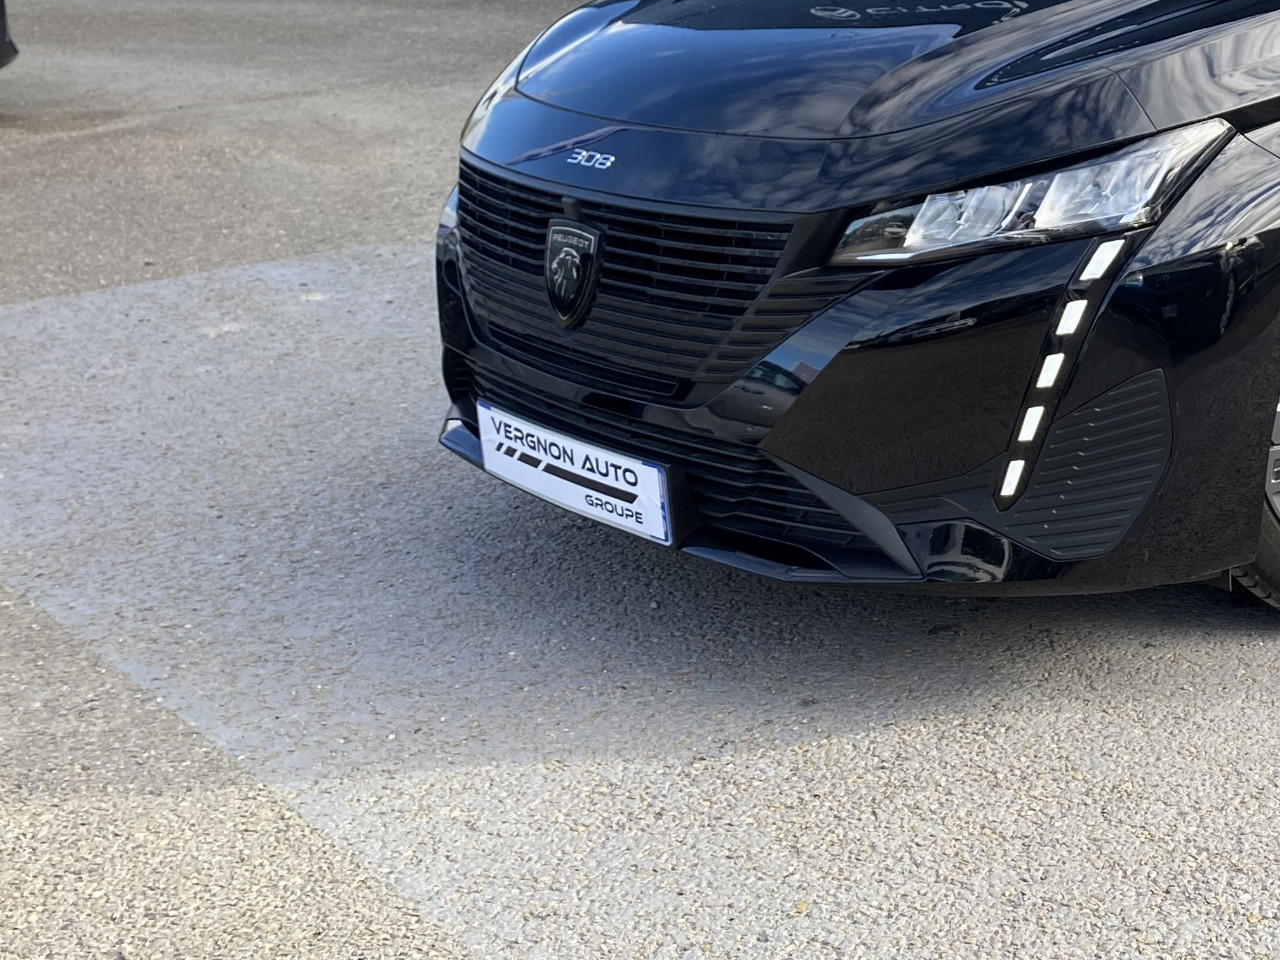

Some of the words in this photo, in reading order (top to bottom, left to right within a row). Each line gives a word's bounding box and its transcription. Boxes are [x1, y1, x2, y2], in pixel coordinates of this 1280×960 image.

[566, 148, 616, 170] 308
[552, 233, 590, 248] PEUGEOT
[490, 416, 575, 467] VERGNON
[581, 454, 638, 487] AUTO
[584, 494, 643, 524] GROUPE
